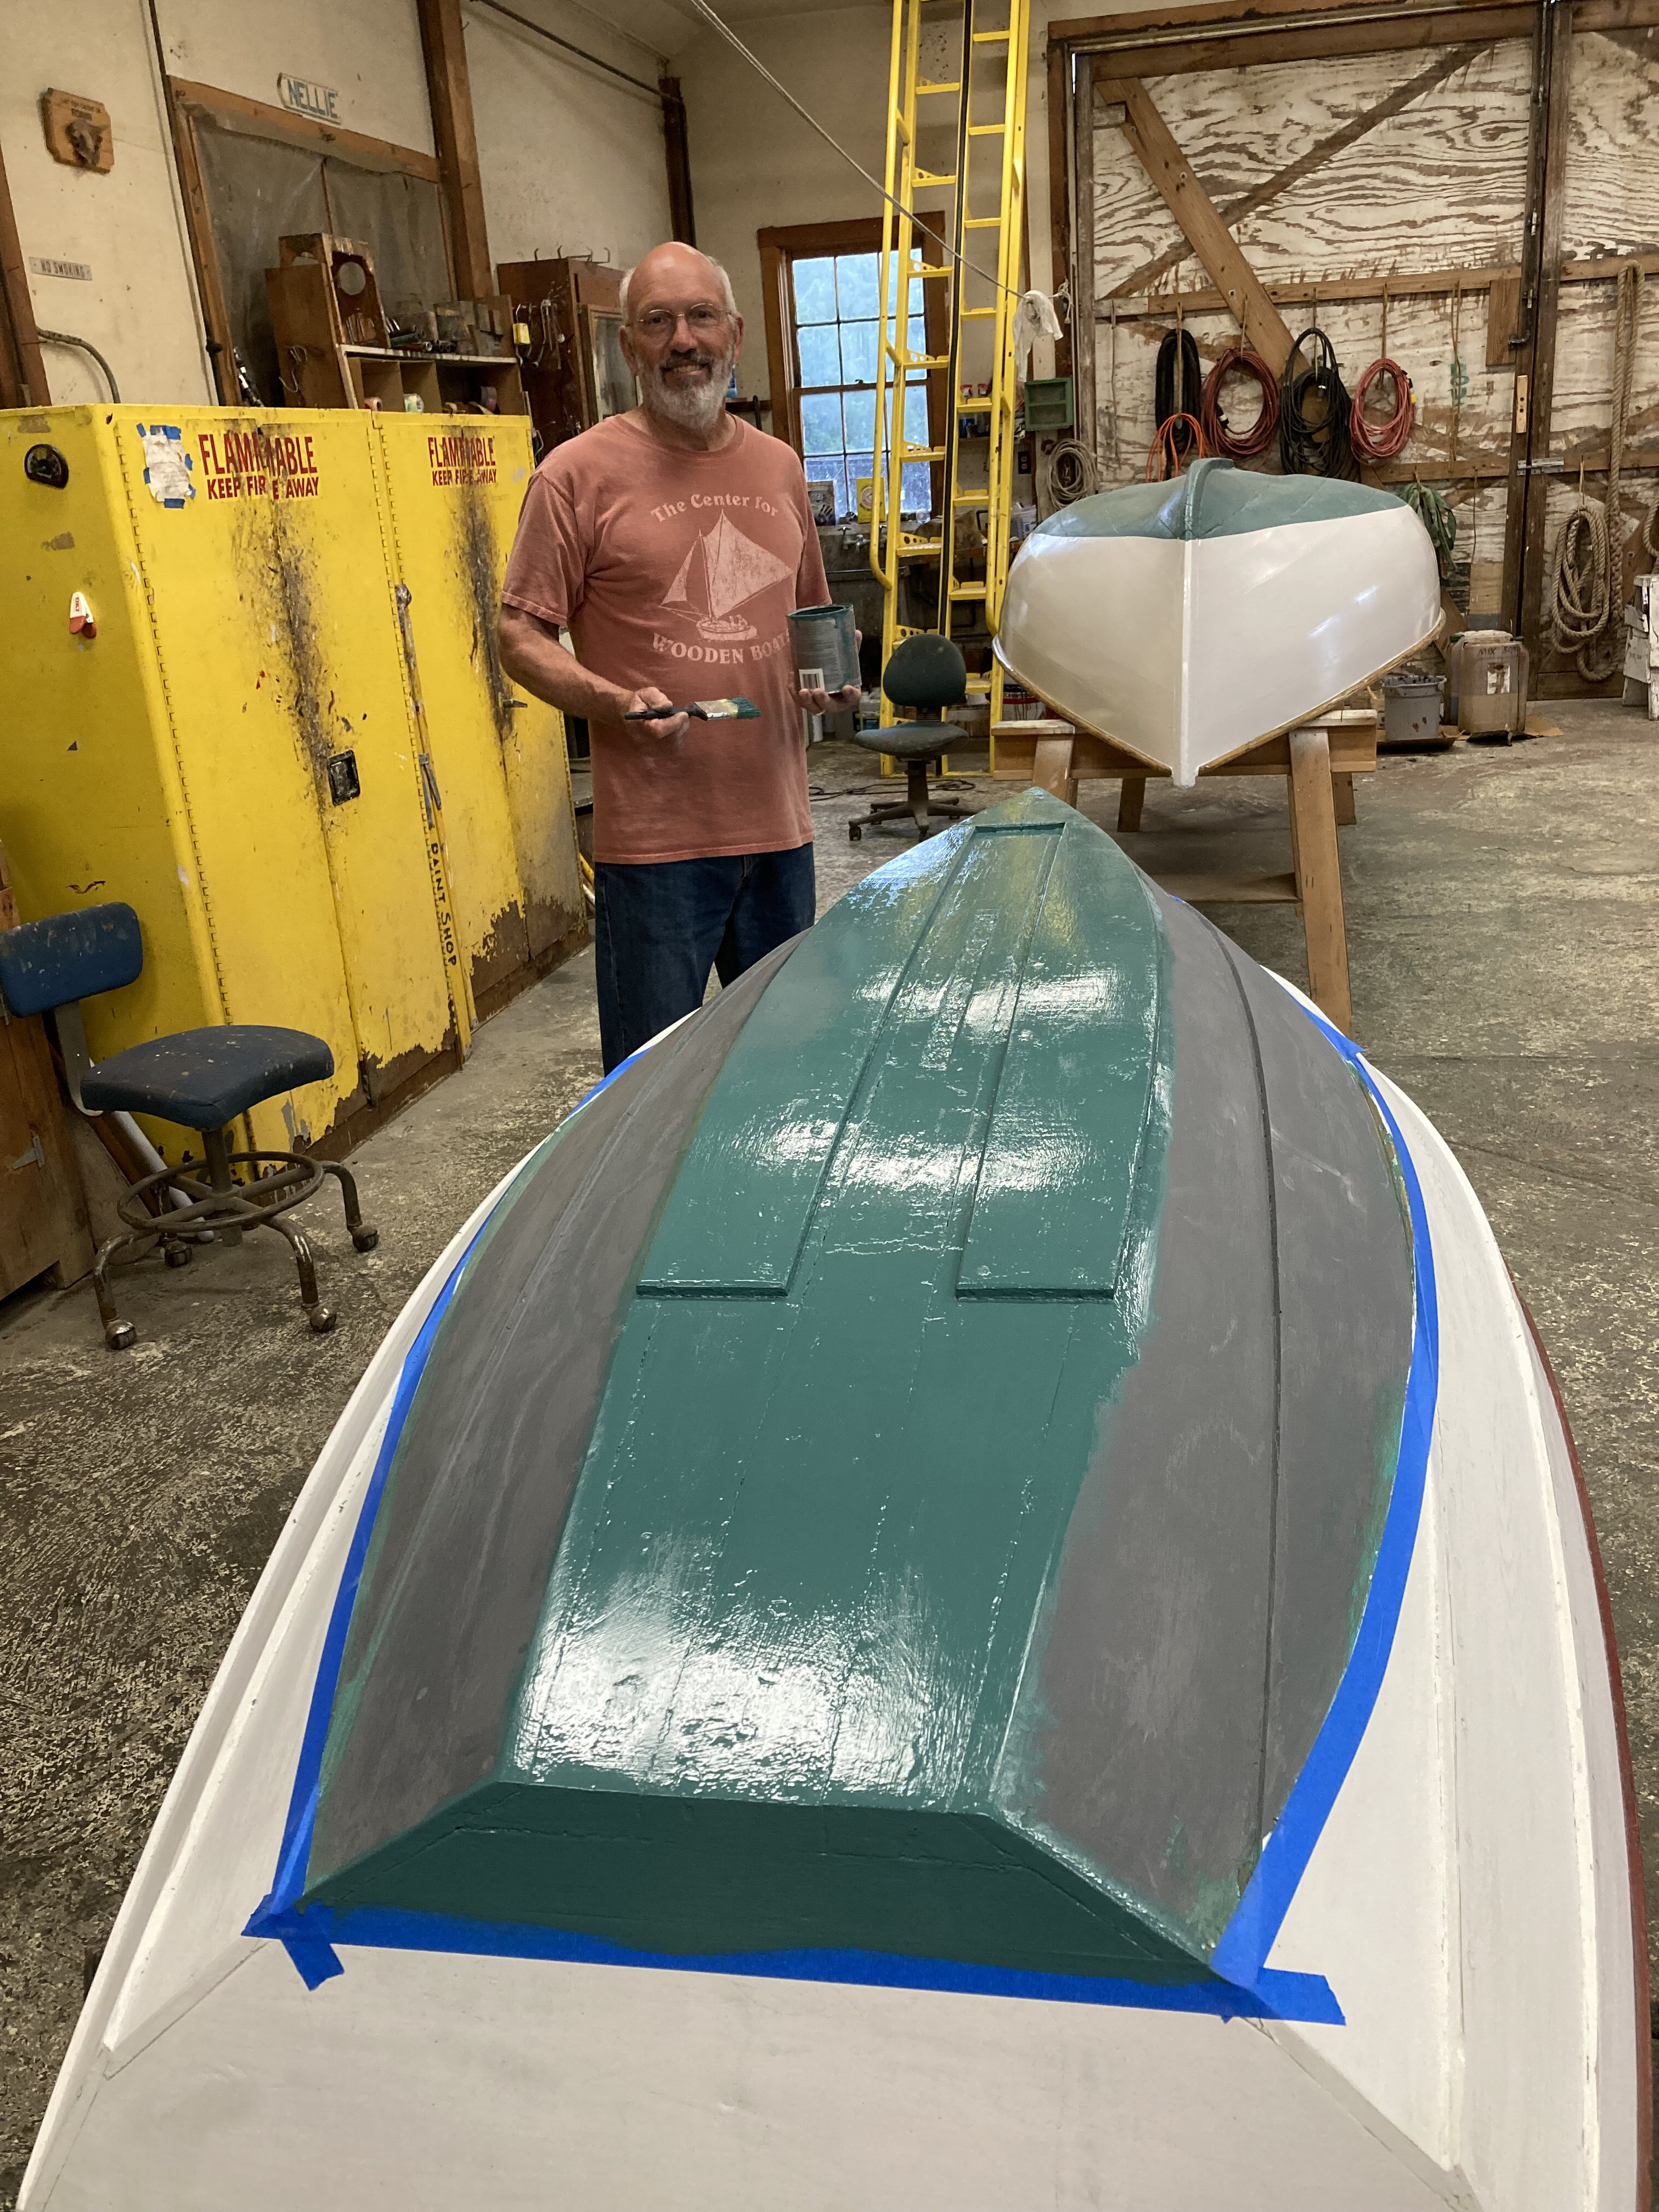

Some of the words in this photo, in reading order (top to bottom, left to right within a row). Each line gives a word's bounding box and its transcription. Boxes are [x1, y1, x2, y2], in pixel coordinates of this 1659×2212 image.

[287, 78, 338, 119] NELLIE
[41, 259, 52, 273] NO
[53, 262, 85, 278] SMOKING
[198, 431, 318, 476] FLAMMABLE
[428, 437, 495, 467] FLAMMABLE
[207, 477, 241, 500] KEEP
[246, 475, 279, 500] FIRE
[285, 476, 319, 499] AWAY
[432, 470, 452, 486] KEEP
[455, 469, 472, 485] FIRE
[477, 469, 496, 484] AWAY
[650, 501, 687, 522] The
[691, 493, 750, 508] Center
[755, 496, 778, 516] for
[653, 633, 744, 664] WOODEN
[441, 911, 457, 966] SHOP
